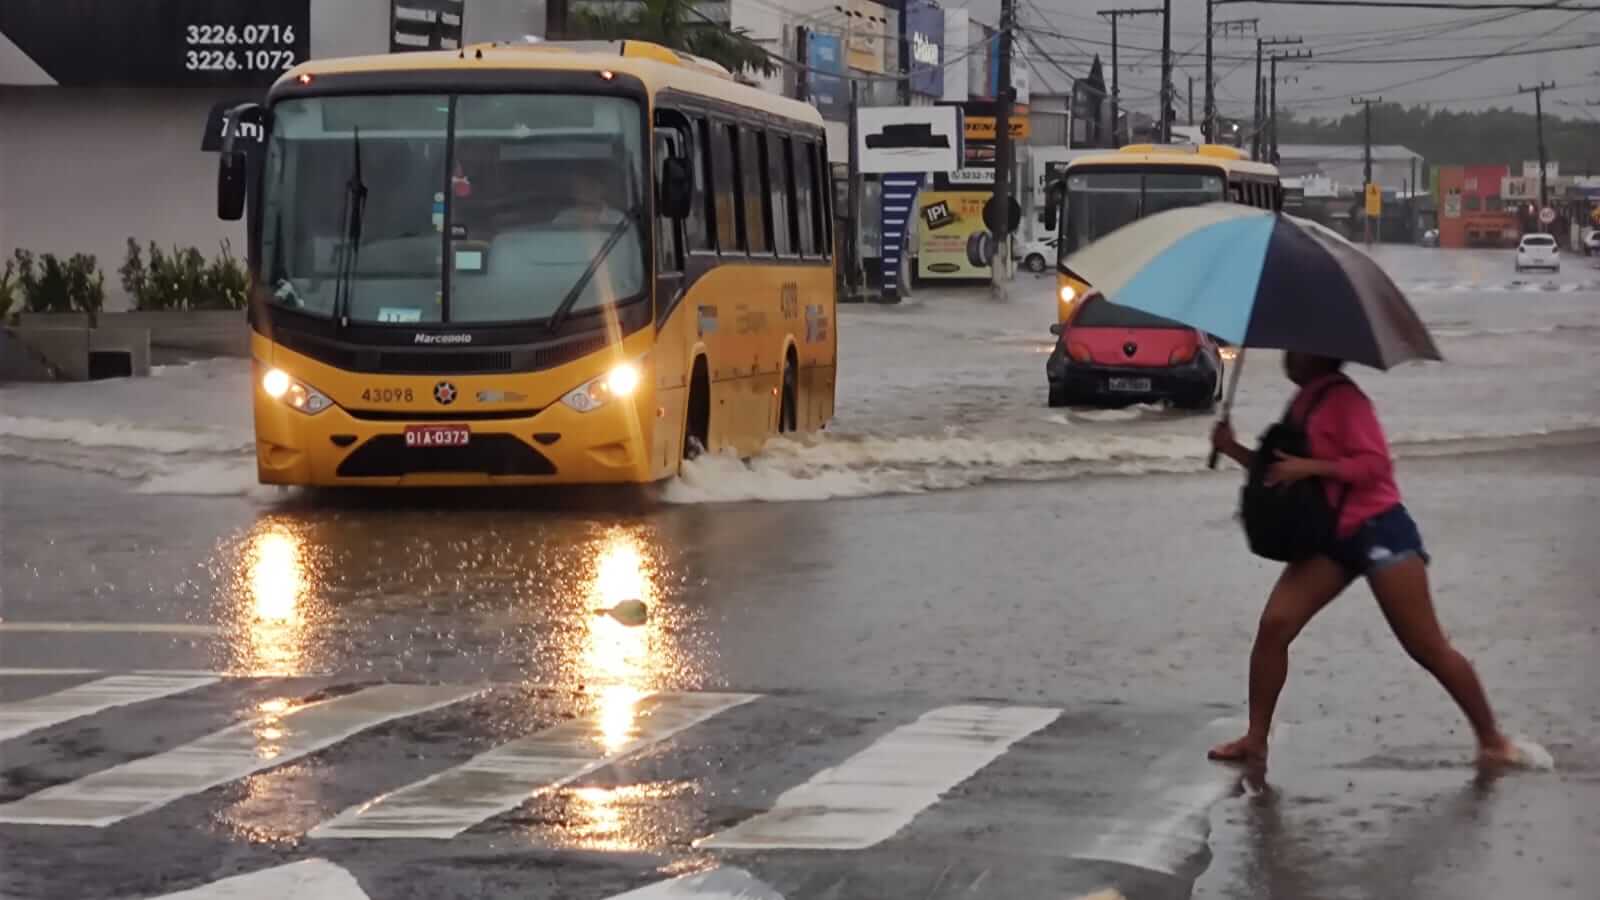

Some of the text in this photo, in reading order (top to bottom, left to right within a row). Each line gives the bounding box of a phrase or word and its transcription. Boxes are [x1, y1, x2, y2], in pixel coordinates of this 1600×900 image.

[186, 25, 295, 44] 3226.0716
[186, 50, 295, 70] 3226.1072
[361, 389, 413, 402] 43098
